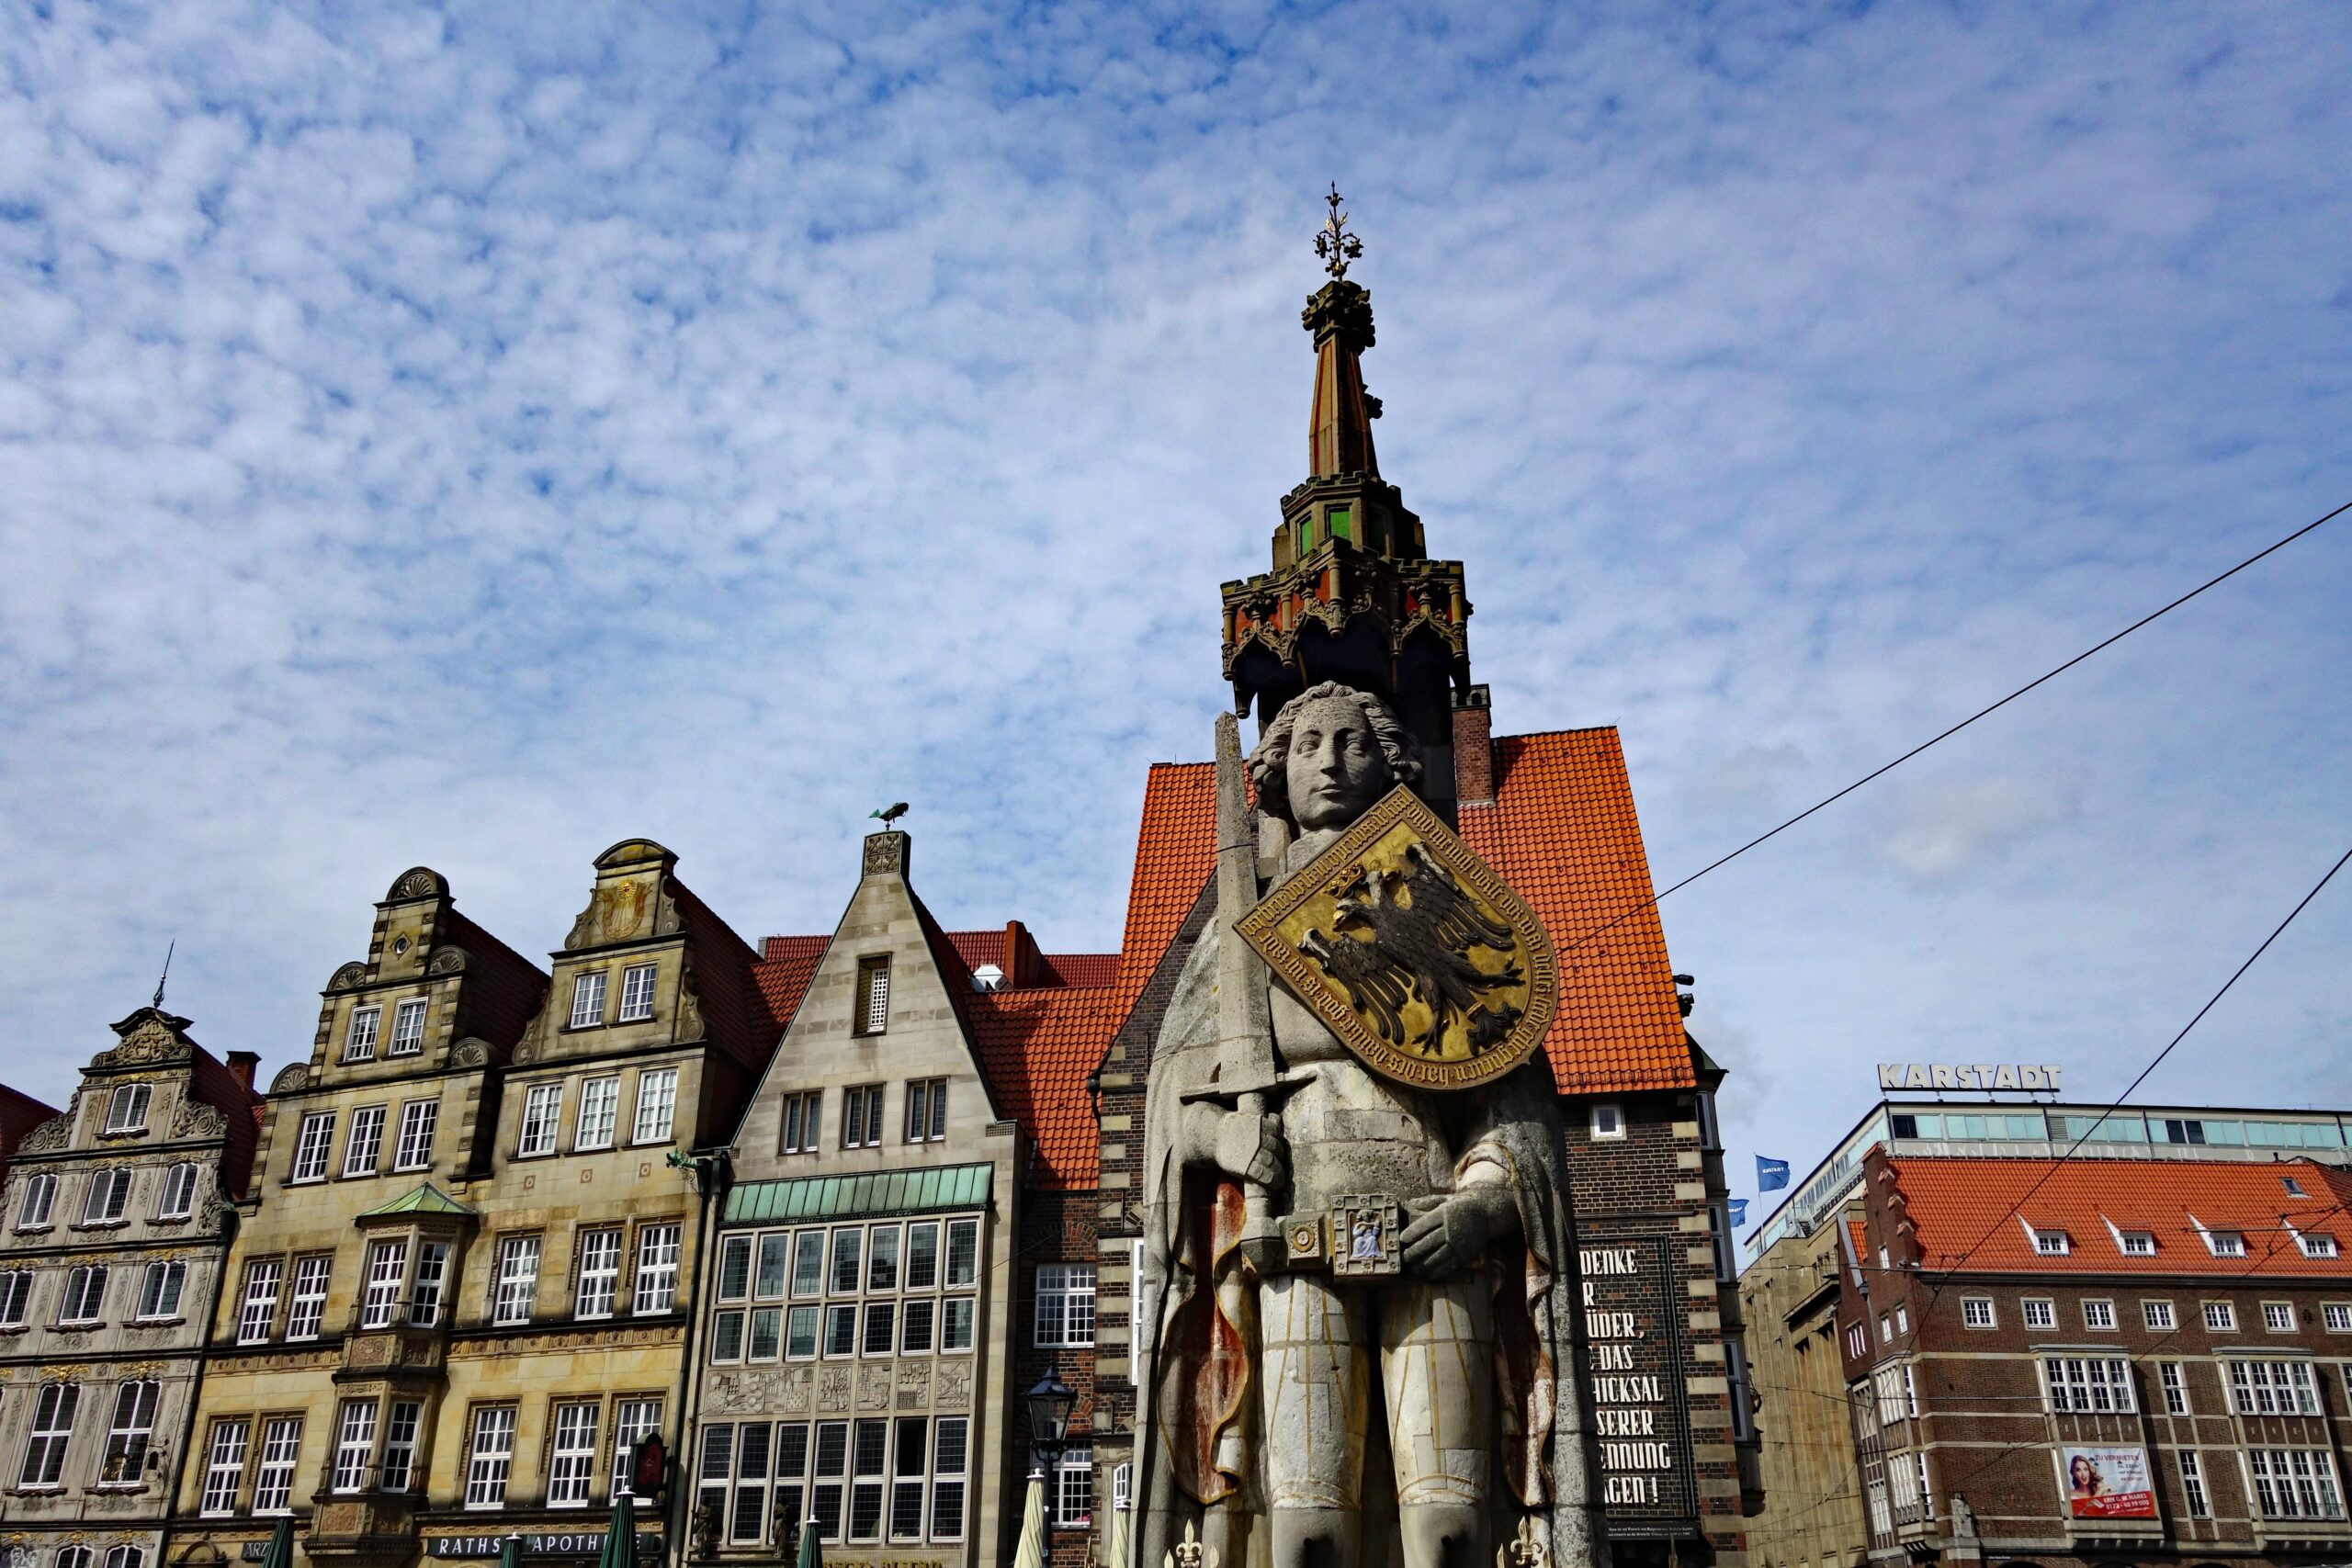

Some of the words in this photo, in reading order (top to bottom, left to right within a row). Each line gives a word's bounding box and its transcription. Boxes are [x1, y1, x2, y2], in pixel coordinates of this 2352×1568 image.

[1878, 1064, 2061, 1089] KARSTADT
[1579, 1249, 1637, 1275] DENKE
[1600, 1345, 1634, 1371] DAS
[1596, 1410, 1654, 1436] SERER
[439, 1537, 501, 1554] RATHS
